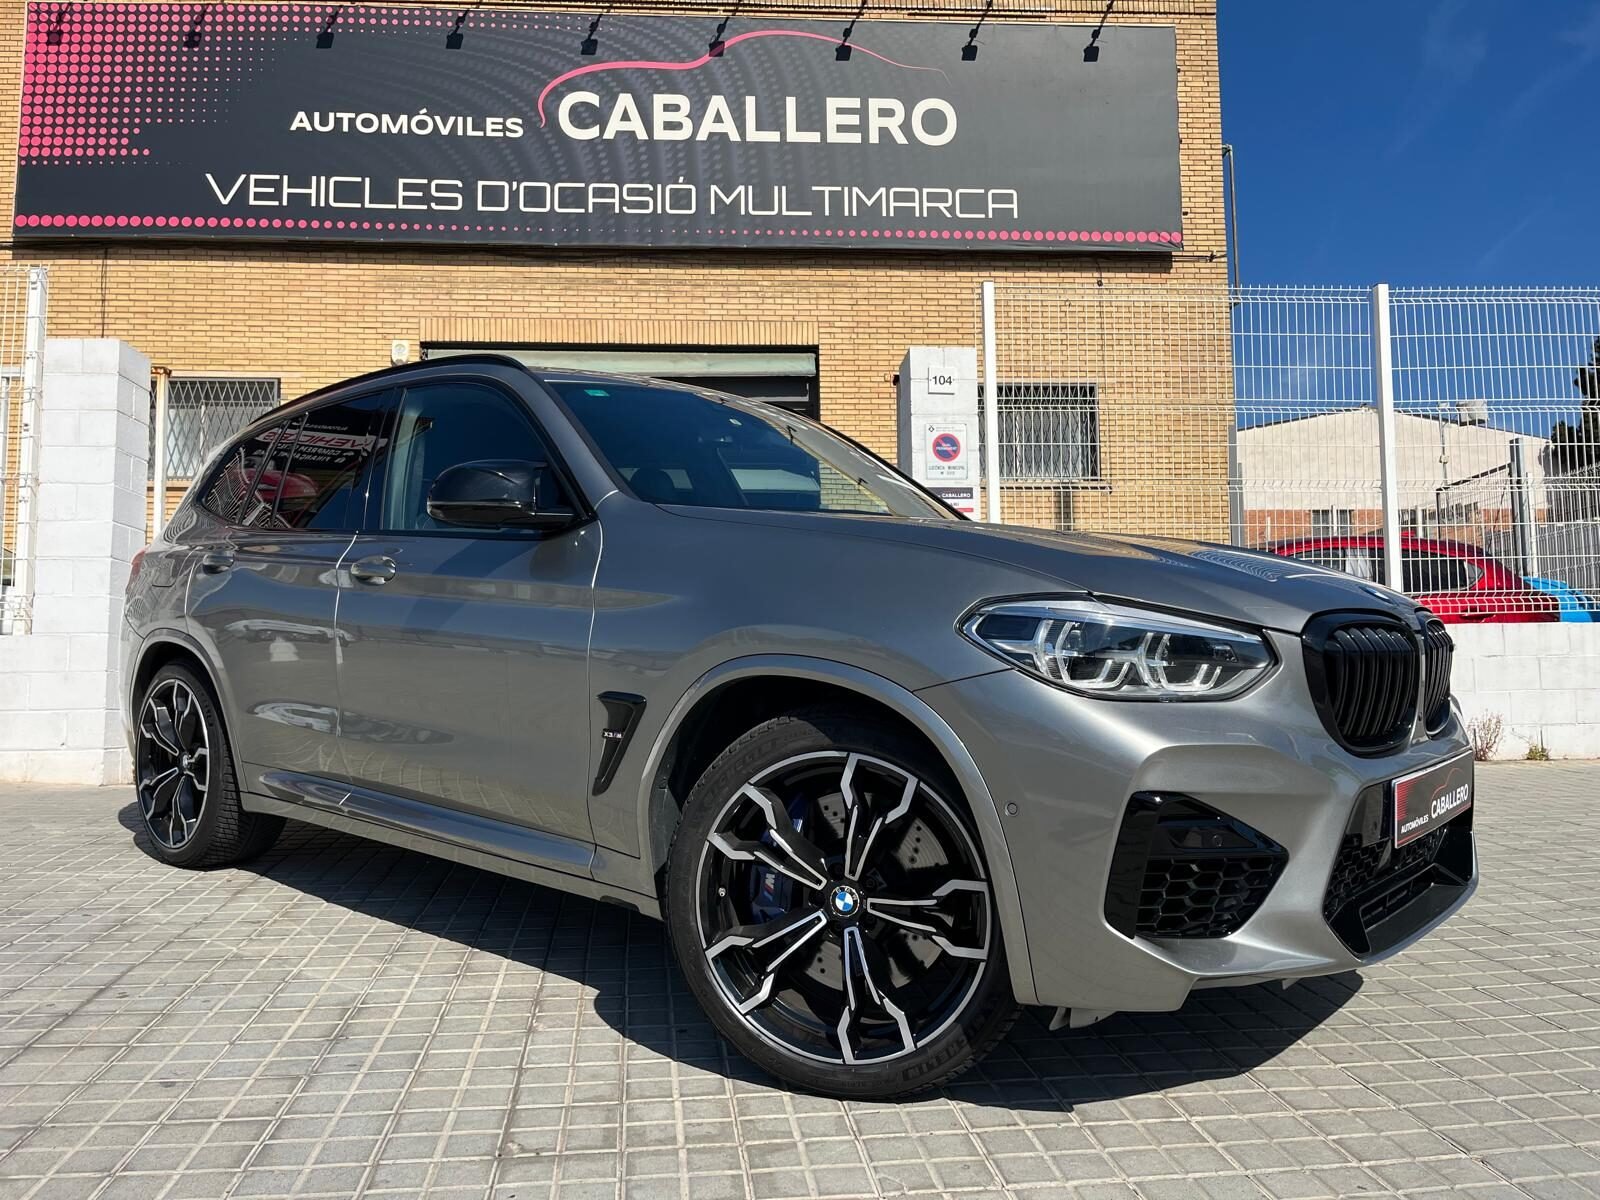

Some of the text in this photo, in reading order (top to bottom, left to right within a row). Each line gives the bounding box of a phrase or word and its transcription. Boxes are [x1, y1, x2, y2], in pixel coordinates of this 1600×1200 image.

[290, 90, 958, 147] AUTOMÓVILES CABALLERO
[205, 173, 1018, 219] VEHICLES D'OCASIÓ MULTIMARCA
[932, 375, 953, 386] 104
[1431, 784, 1468, 818] CABALLERO
